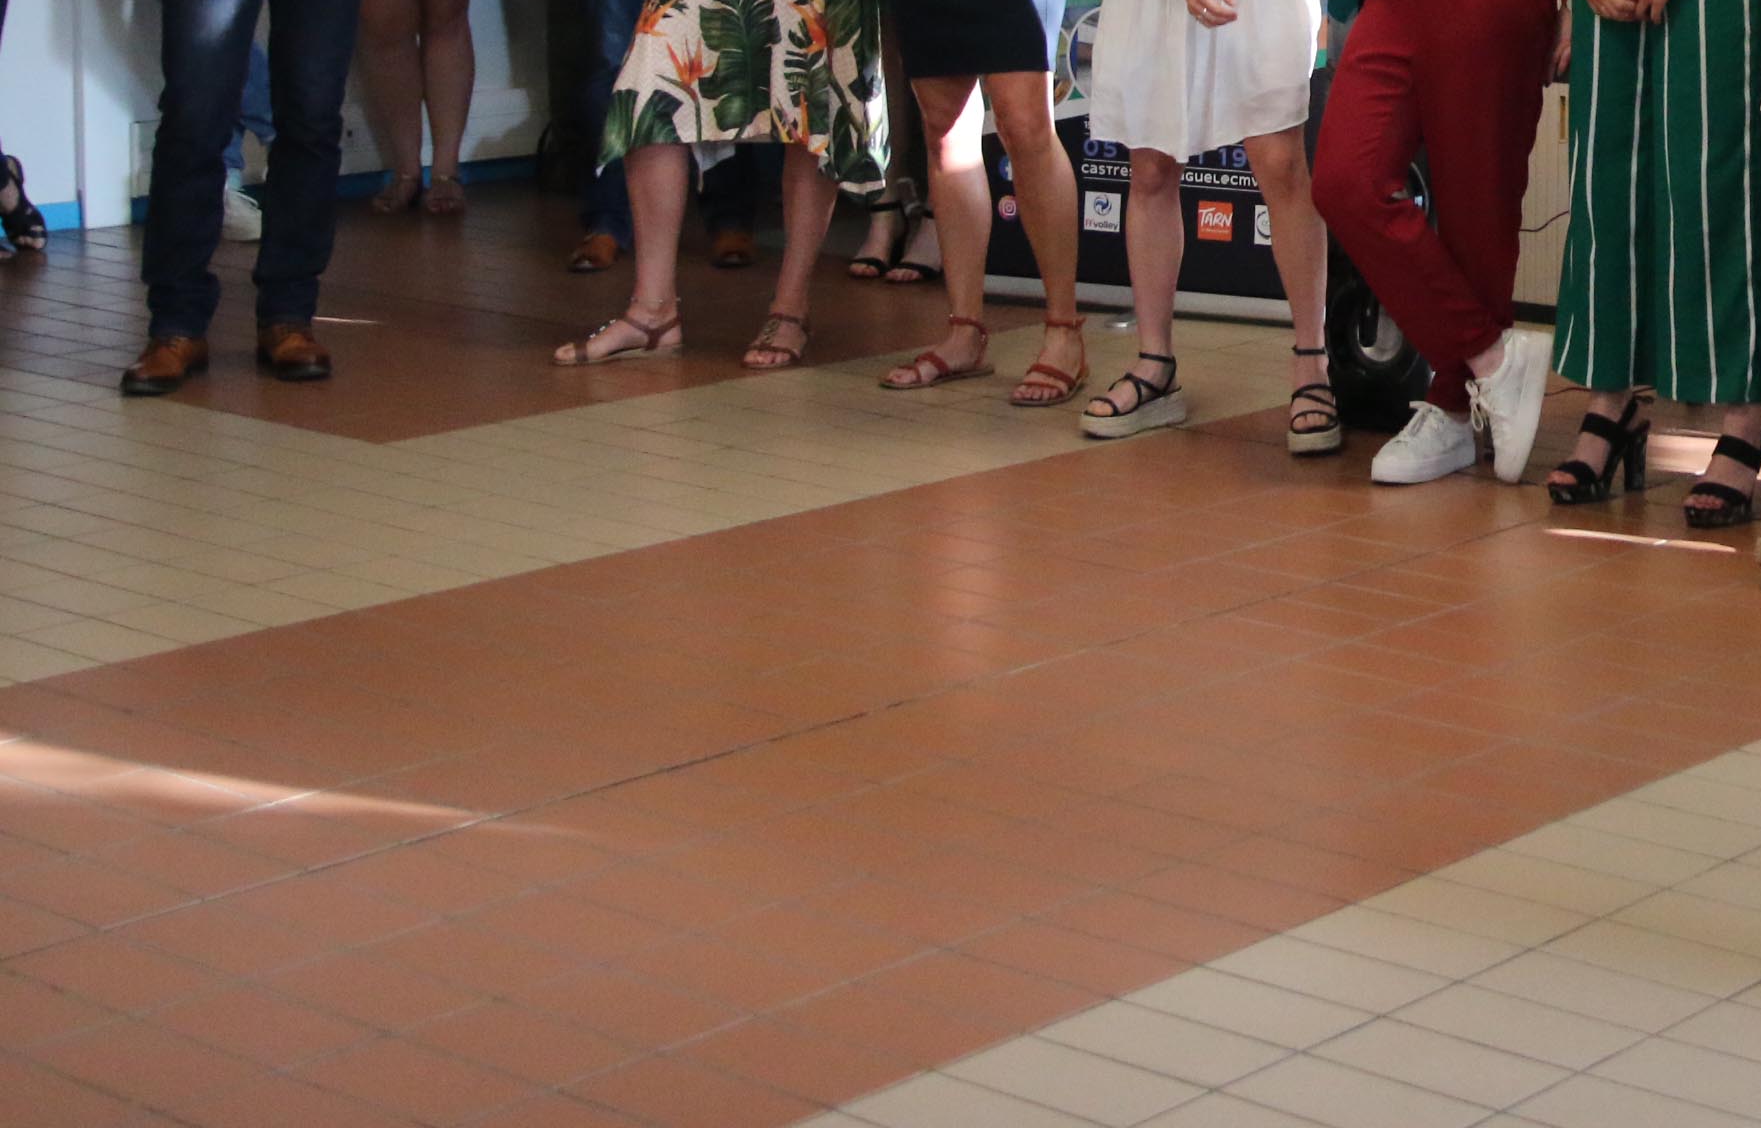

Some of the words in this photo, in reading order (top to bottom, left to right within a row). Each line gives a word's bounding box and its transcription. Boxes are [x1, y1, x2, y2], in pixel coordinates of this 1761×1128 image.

[1083, 138, 1117, 158] 05
[1218, 147, 1248, 168] 19
[1081, 163, 1132, 177] casTre
[1199, 207, 1233, 227] TARN
